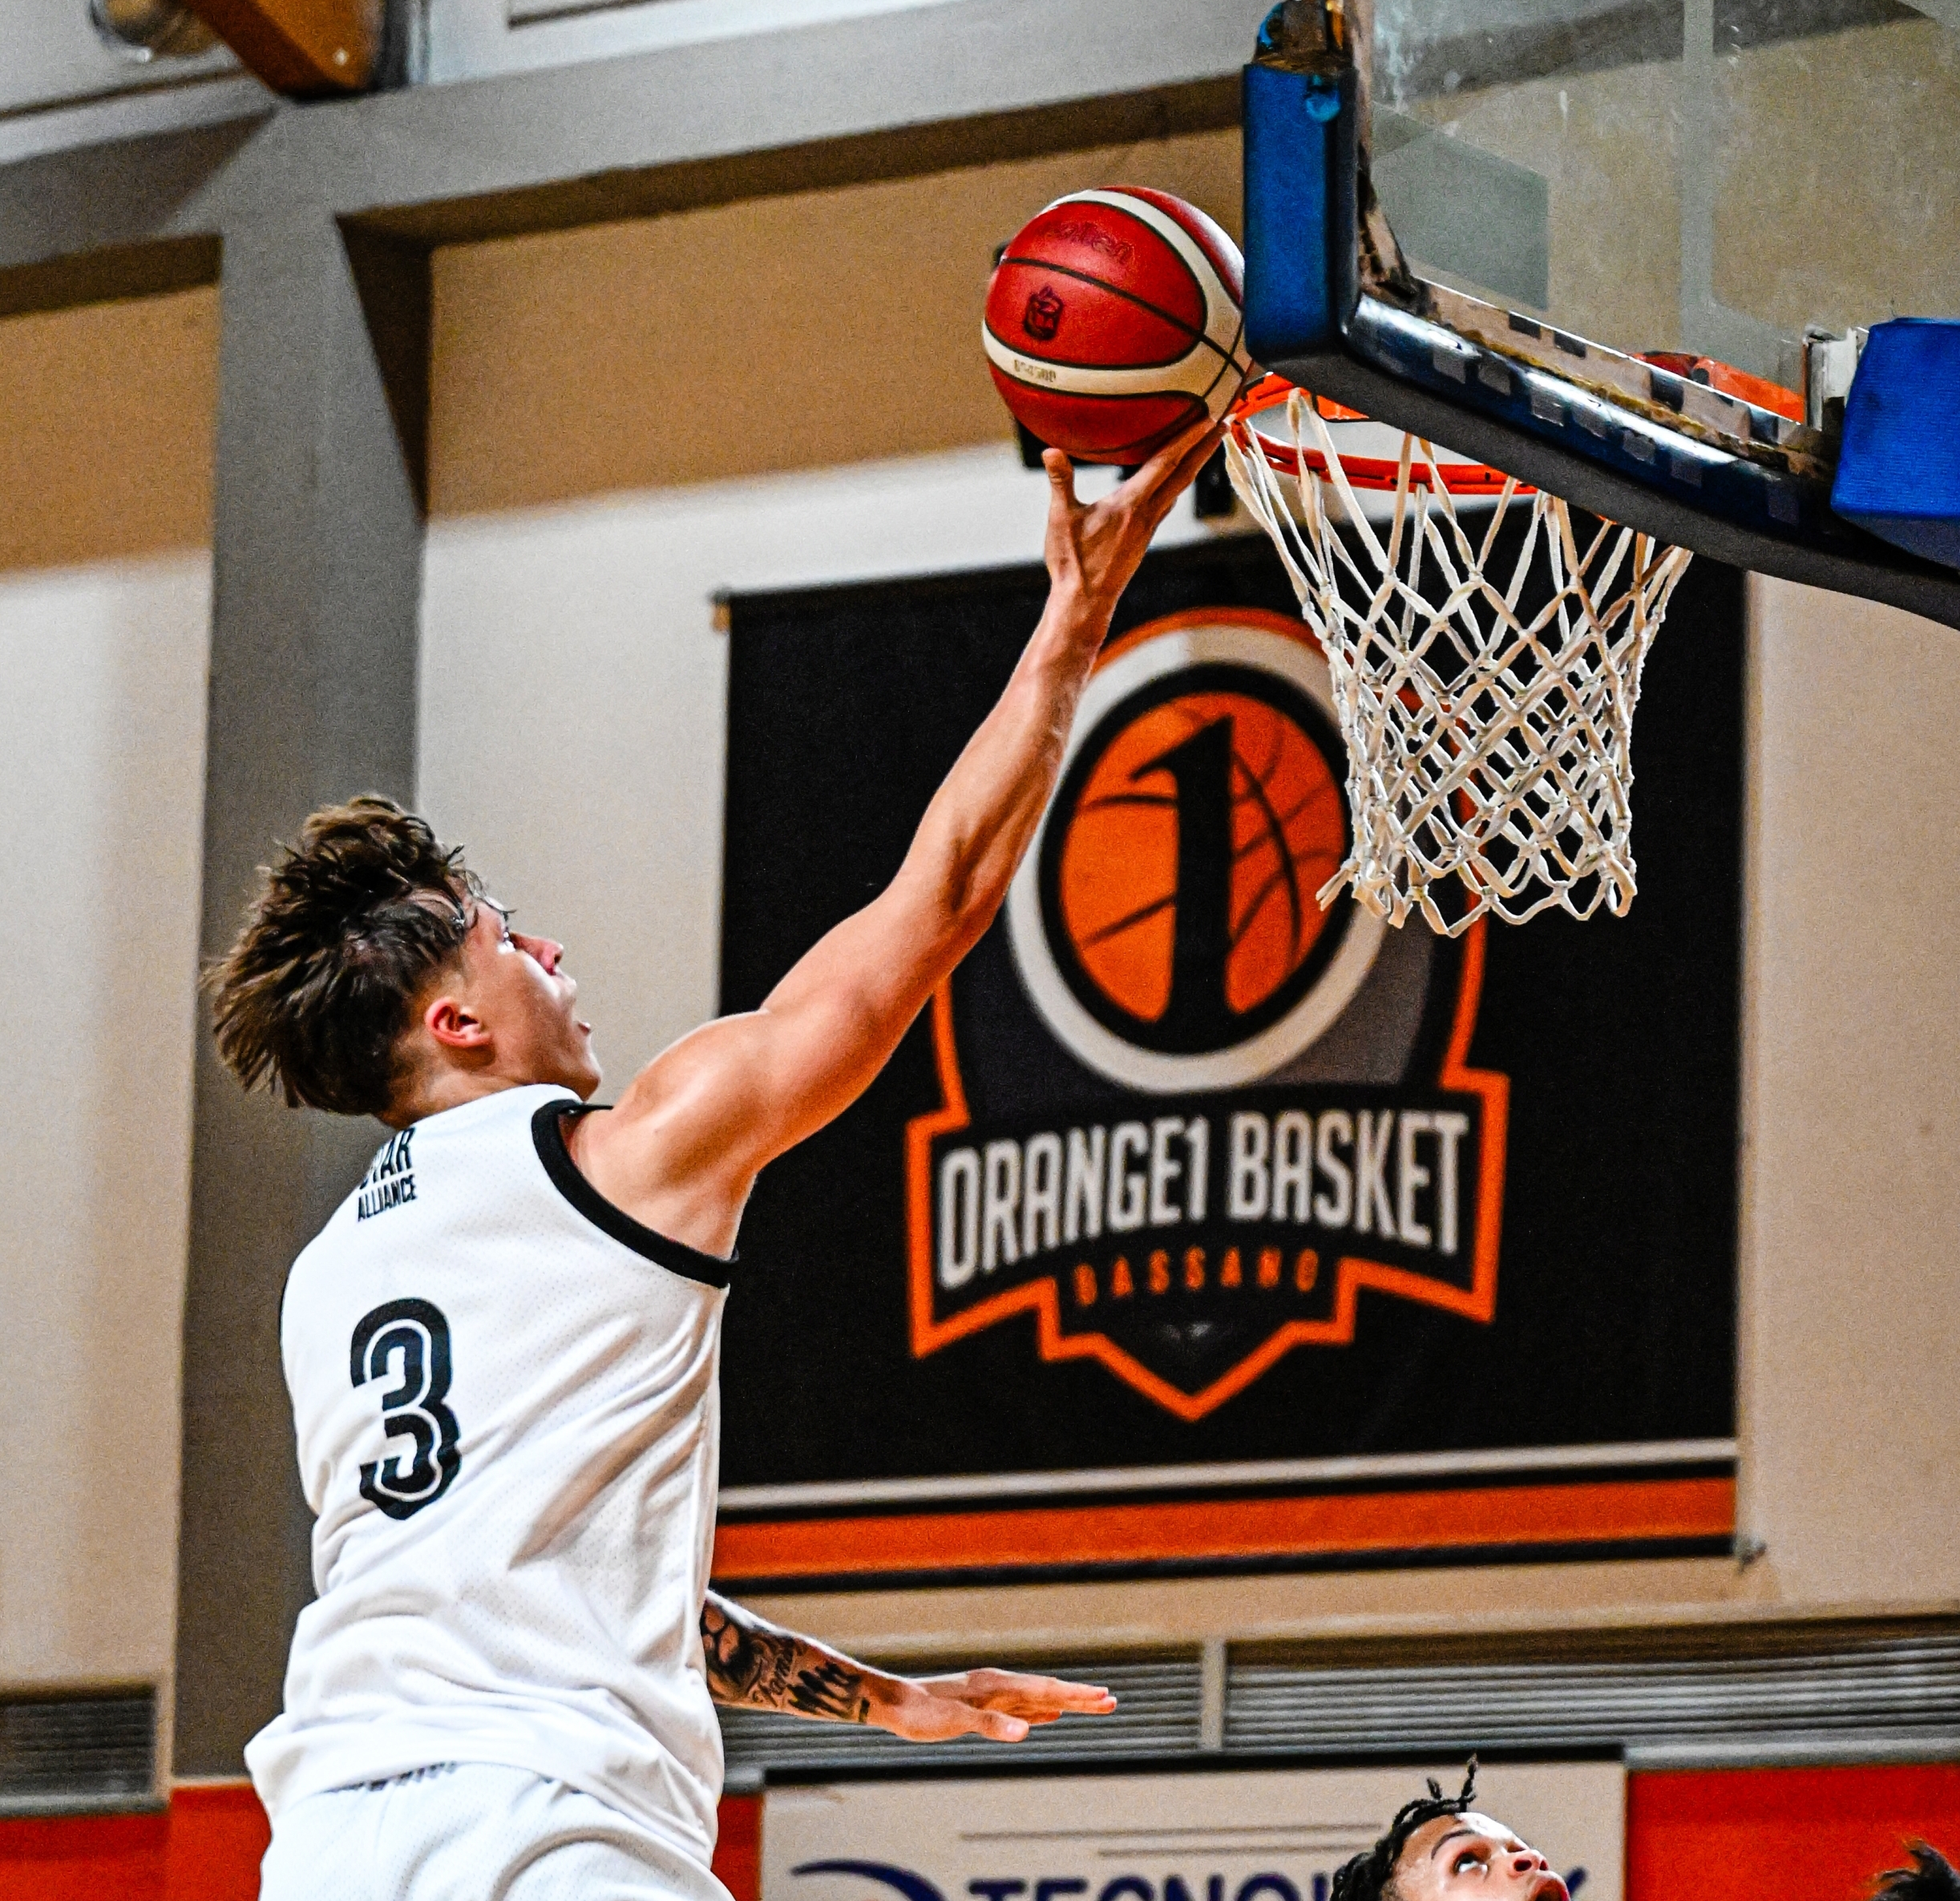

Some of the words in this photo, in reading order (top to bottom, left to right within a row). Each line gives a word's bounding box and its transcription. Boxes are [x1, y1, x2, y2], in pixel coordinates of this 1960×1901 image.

[358, 1173, 417, 1222] ALLIANCE
[939, 1116, 1210, 1289] ORANGE1
[1227, 1109, 1469, 1255] BASKET
[350, 1298, 462, 1520] 3
